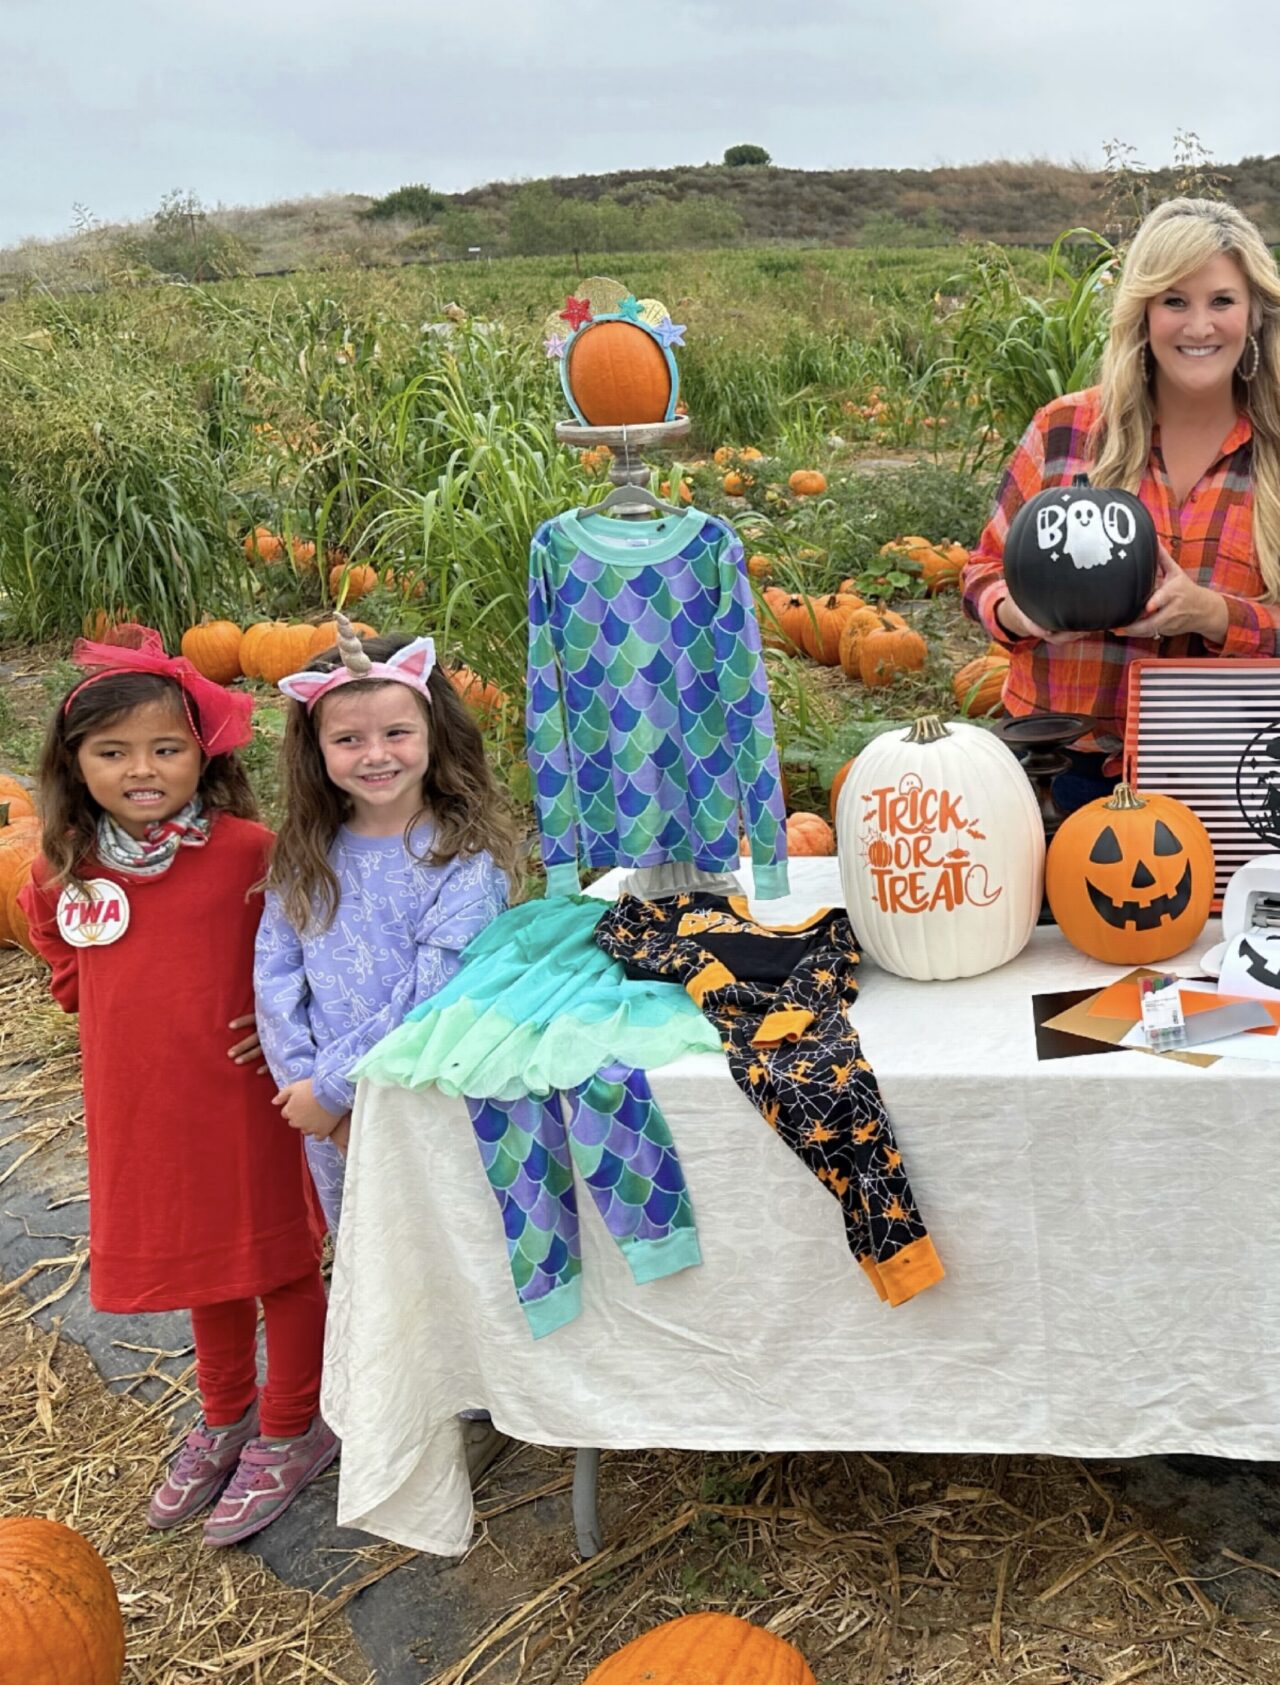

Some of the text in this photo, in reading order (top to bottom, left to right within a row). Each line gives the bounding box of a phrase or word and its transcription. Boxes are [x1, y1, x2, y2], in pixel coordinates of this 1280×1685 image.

[872, 786, 969, 836] TRICK
[894, 835, 945, 870] OR
[870, 861, 971, 914] TREAT
[64, 899, 121, 927] TWA
